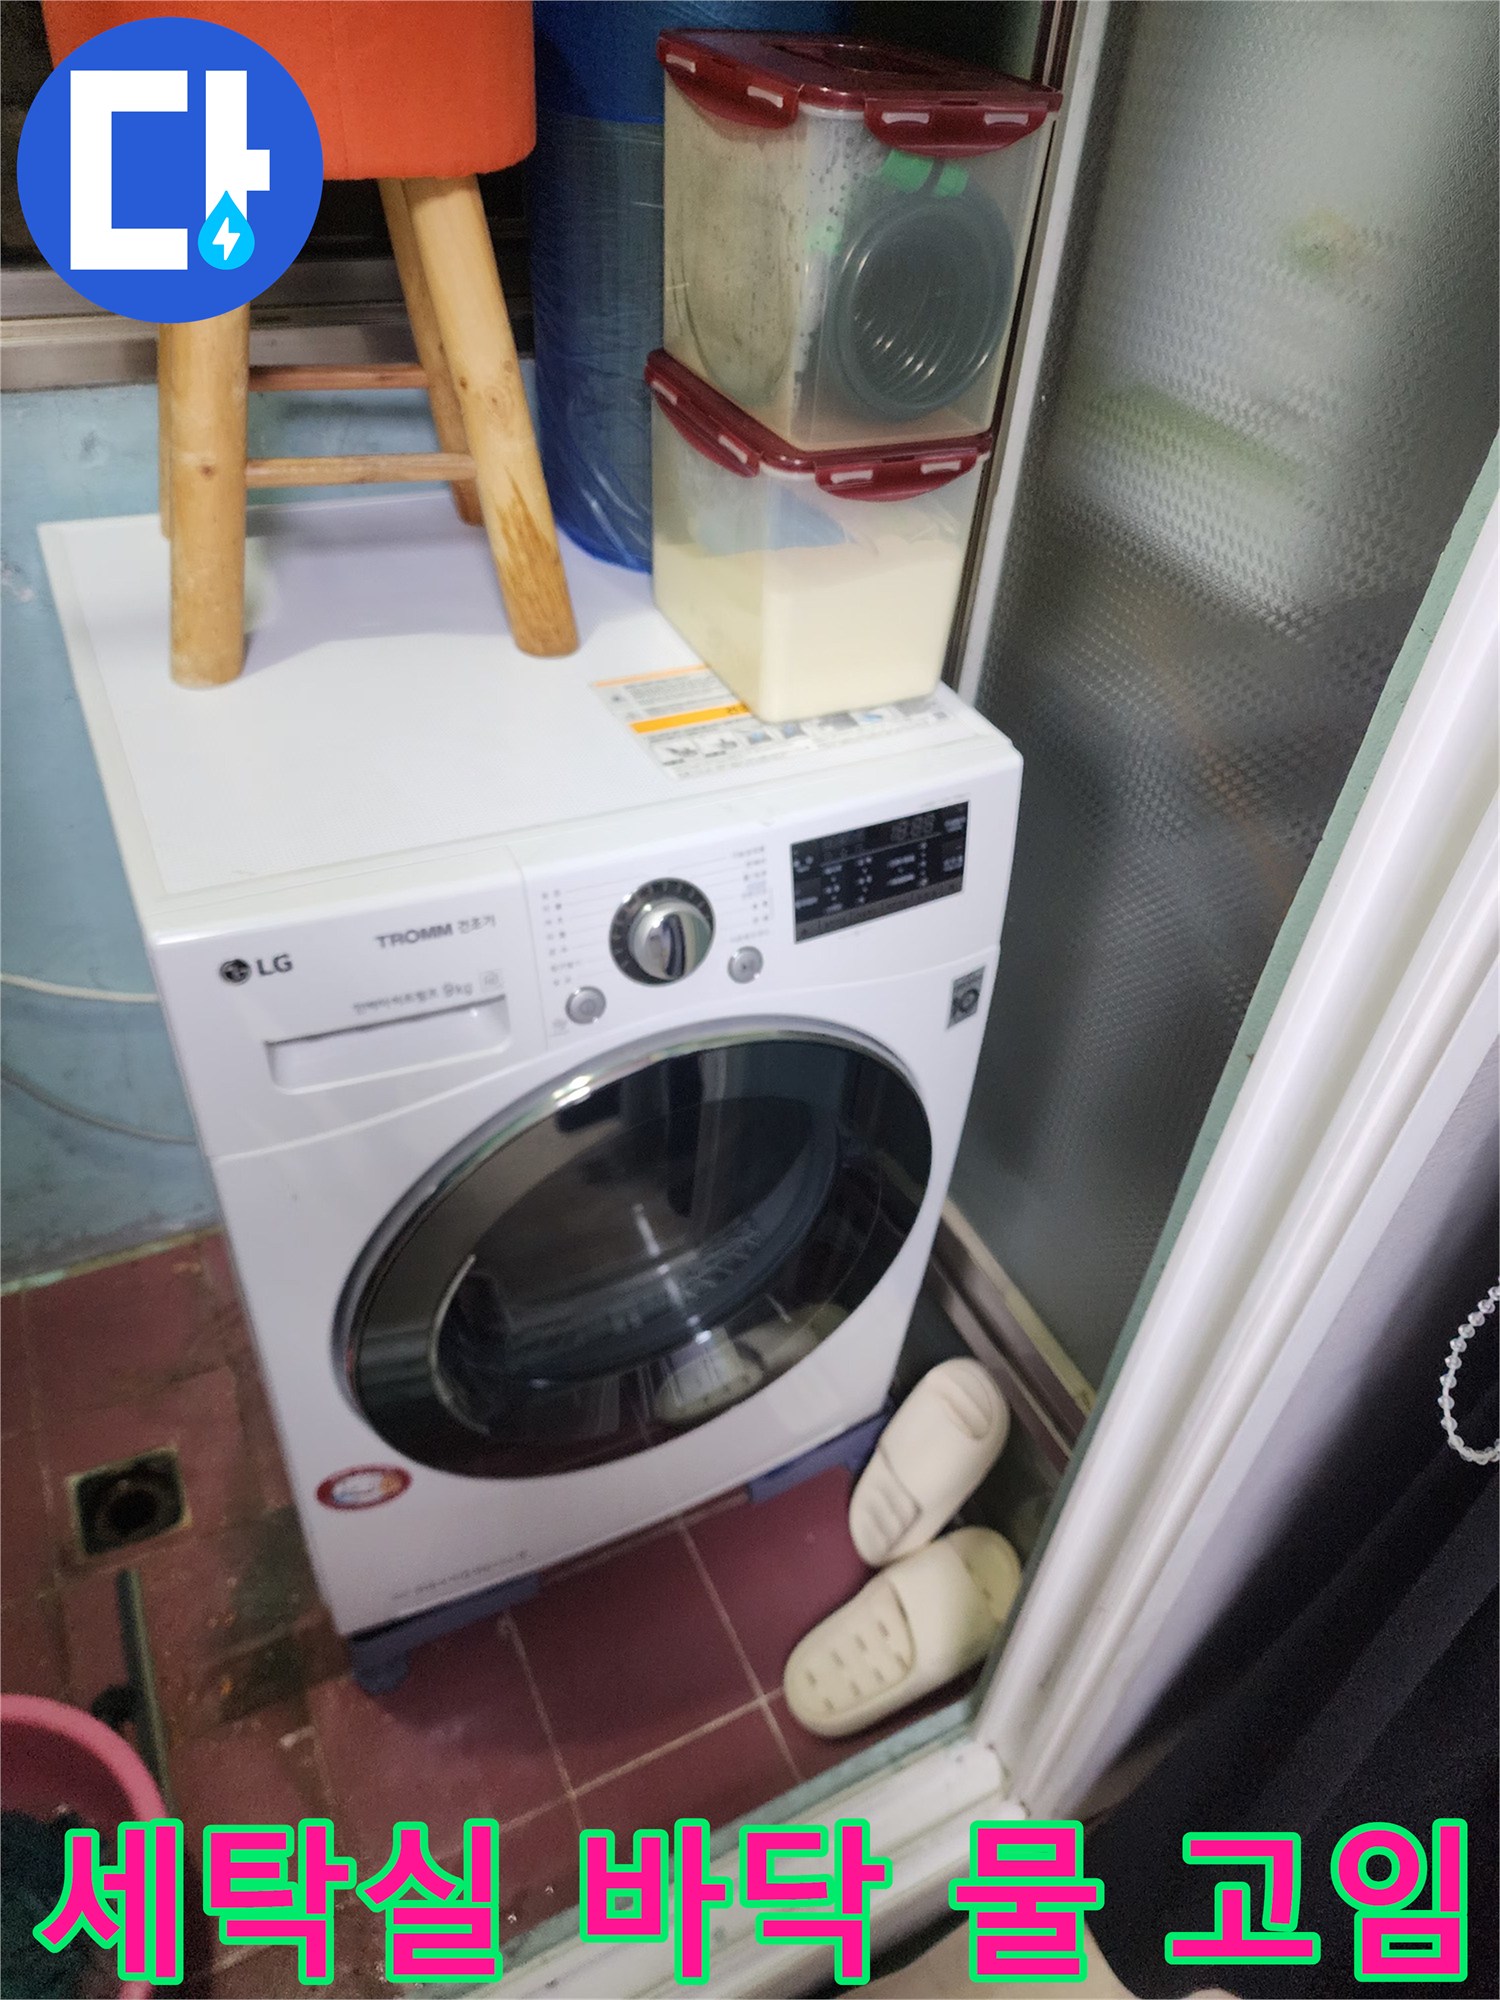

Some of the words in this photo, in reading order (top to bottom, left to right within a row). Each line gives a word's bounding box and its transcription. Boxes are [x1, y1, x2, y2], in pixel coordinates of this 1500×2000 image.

[374, 923, 453, 948] TROMM
[458, 915, 496, 935] 건조기
[256, 953, 293, 976] LG
